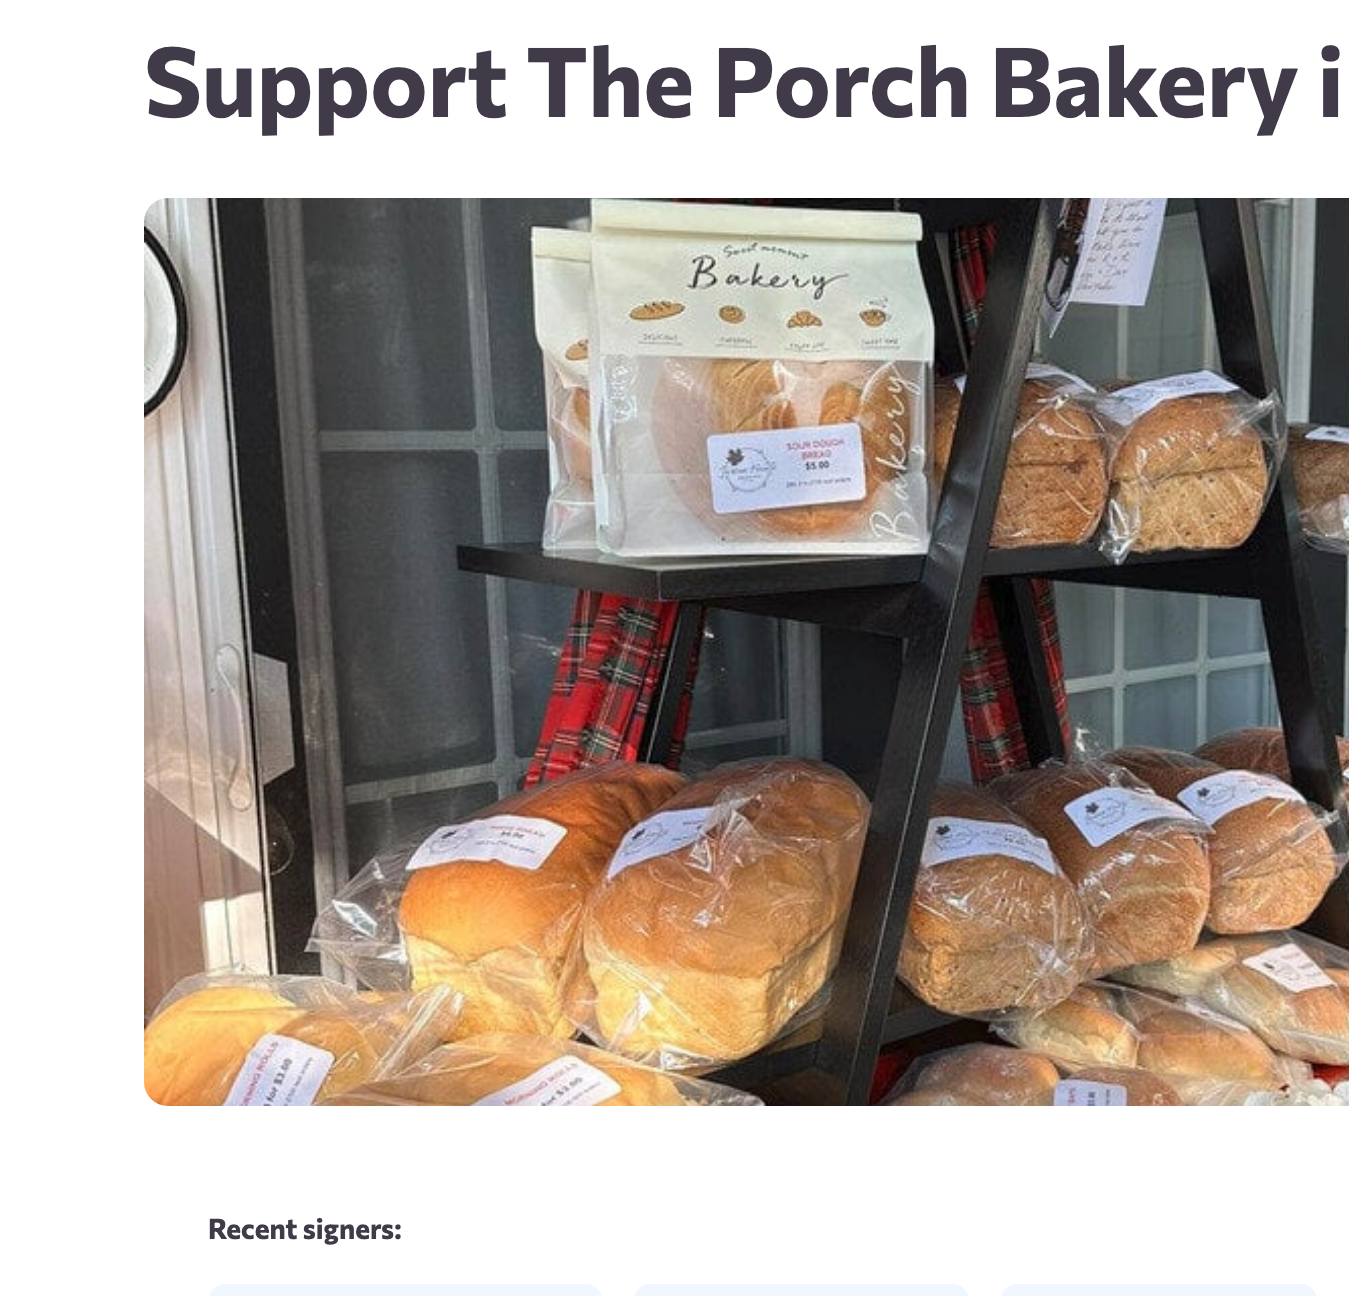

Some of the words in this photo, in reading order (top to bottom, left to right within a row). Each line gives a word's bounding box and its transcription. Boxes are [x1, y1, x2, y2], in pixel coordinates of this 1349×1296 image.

[147, 46, 507, 137] Support
[527, 44, 692, 119] The
[718, 44, 967, 119] Porch
[995, 44, 1299, 137] Bakery
[687, 254, 849, 301] Bakery
[869, 362, 921, 542] Bakery
[209, 1218, 298, 1240] Recent
[303, 1217, 402, 1246] signers:
